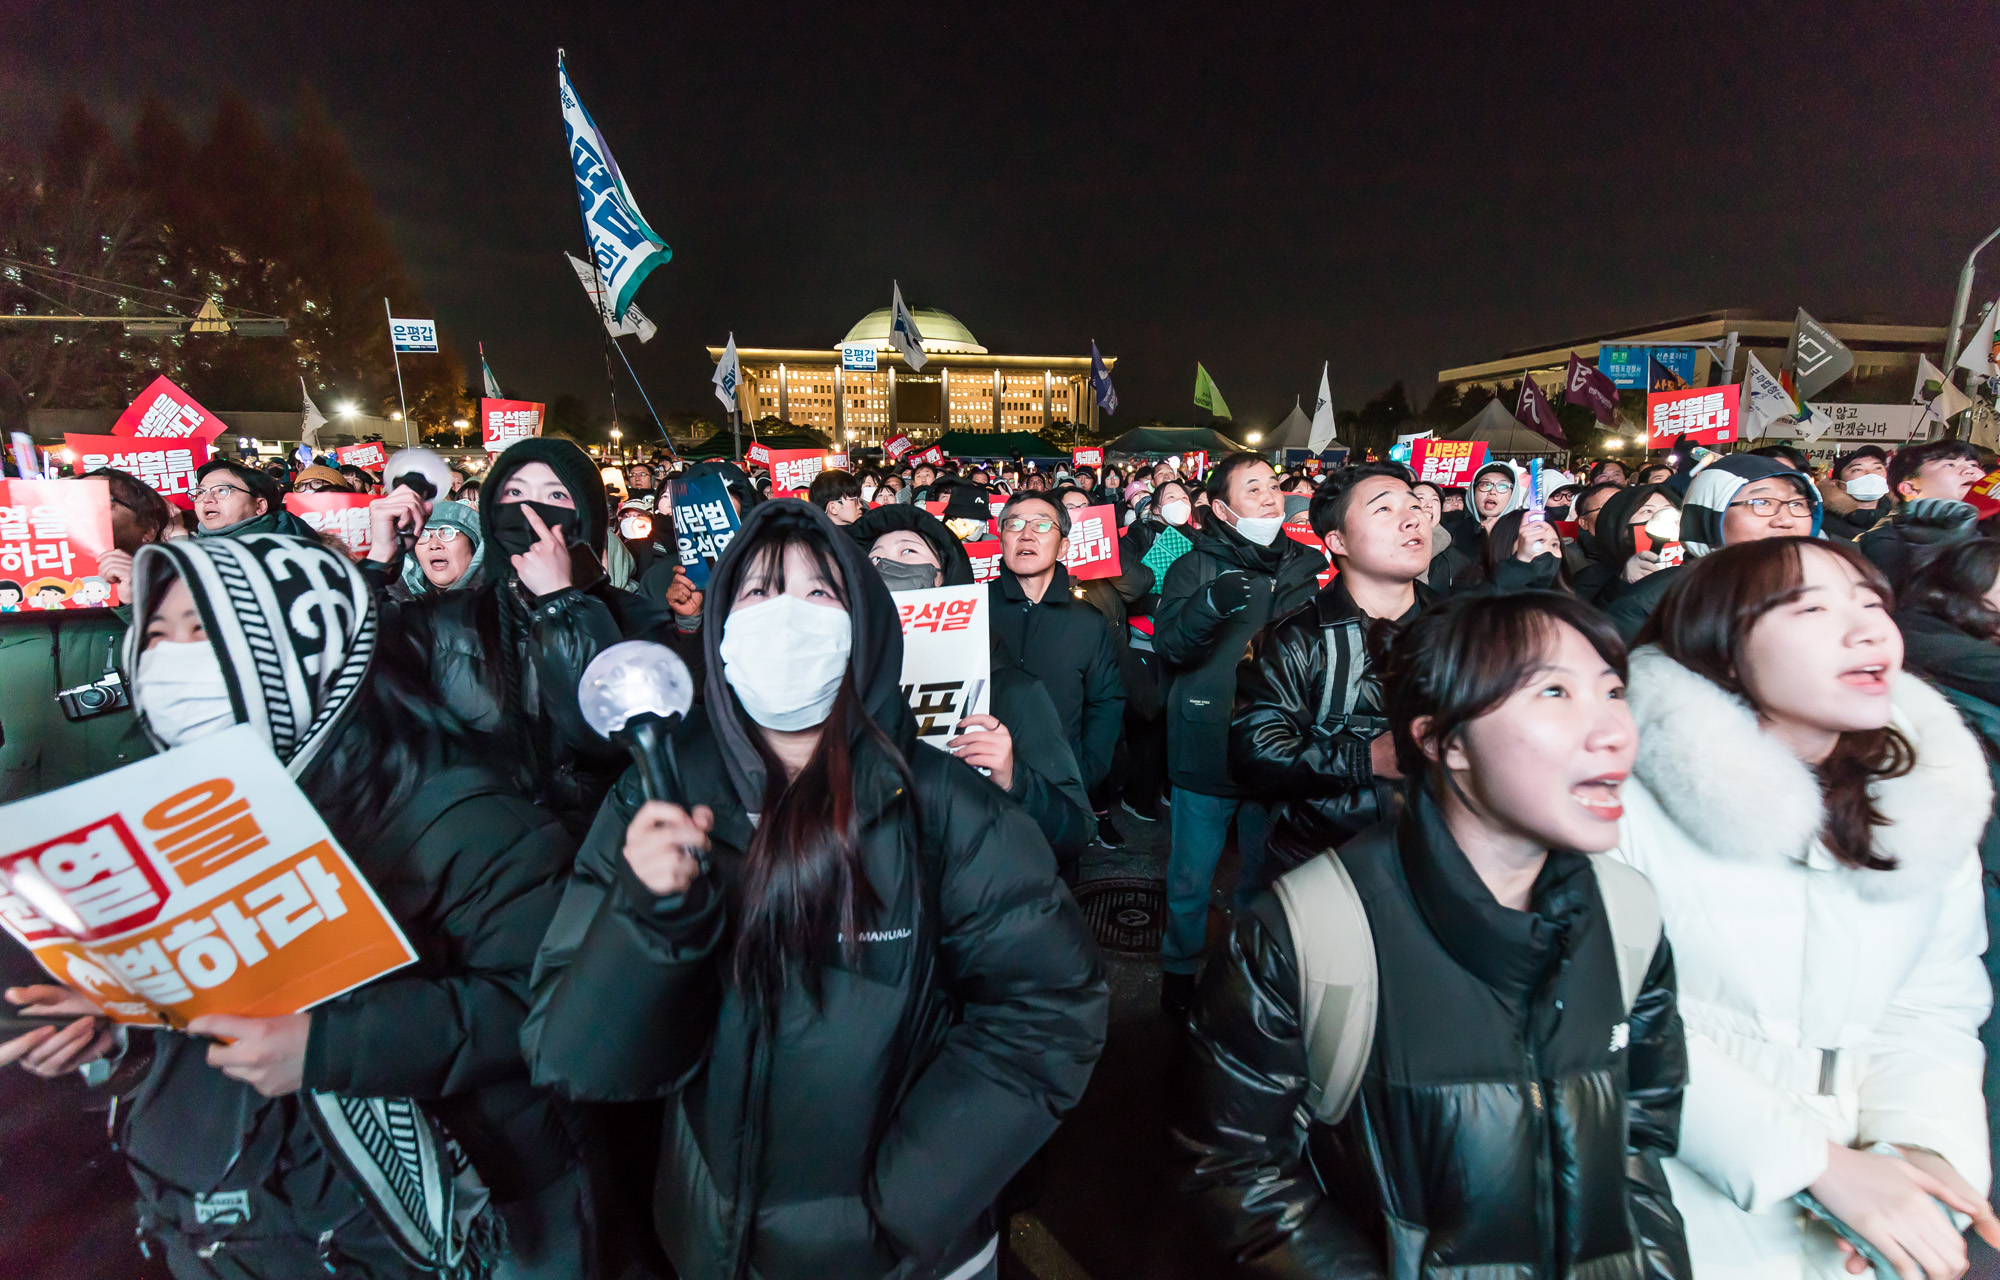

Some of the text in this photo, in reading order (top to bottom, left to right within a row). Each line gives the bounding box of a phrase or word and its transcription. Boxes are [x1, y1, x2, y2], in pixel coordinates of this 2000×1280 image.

[394, 325, 433, 341] 은평갑
[844, 348, 875, 362] 은평갑
[1653, 392, 1725, 423] 윤석열을
[1836, 406, 1858, 420] 않고
[488, 410, 540, 426] 윤석열을
[1653, 408, 1730, 438] 거부한다!
[1834, 422, 1887, 437] 막겠습니다
[1425, 441, 1474, 457] 내란죄
[82, 448, 195, 479] 윤석열을
[775, 456, 823, 477] 윤석열을
[1422, 456, 1471, 472] 윤석열
[299, 506, 371, 532] 윤석열
[672, 500, 731, 535] 내란범
[0, 541, 76, 577] 하라
[1056, 536, 1113, 568] 한다!
[858, 928, 912, 942] MANUAL
